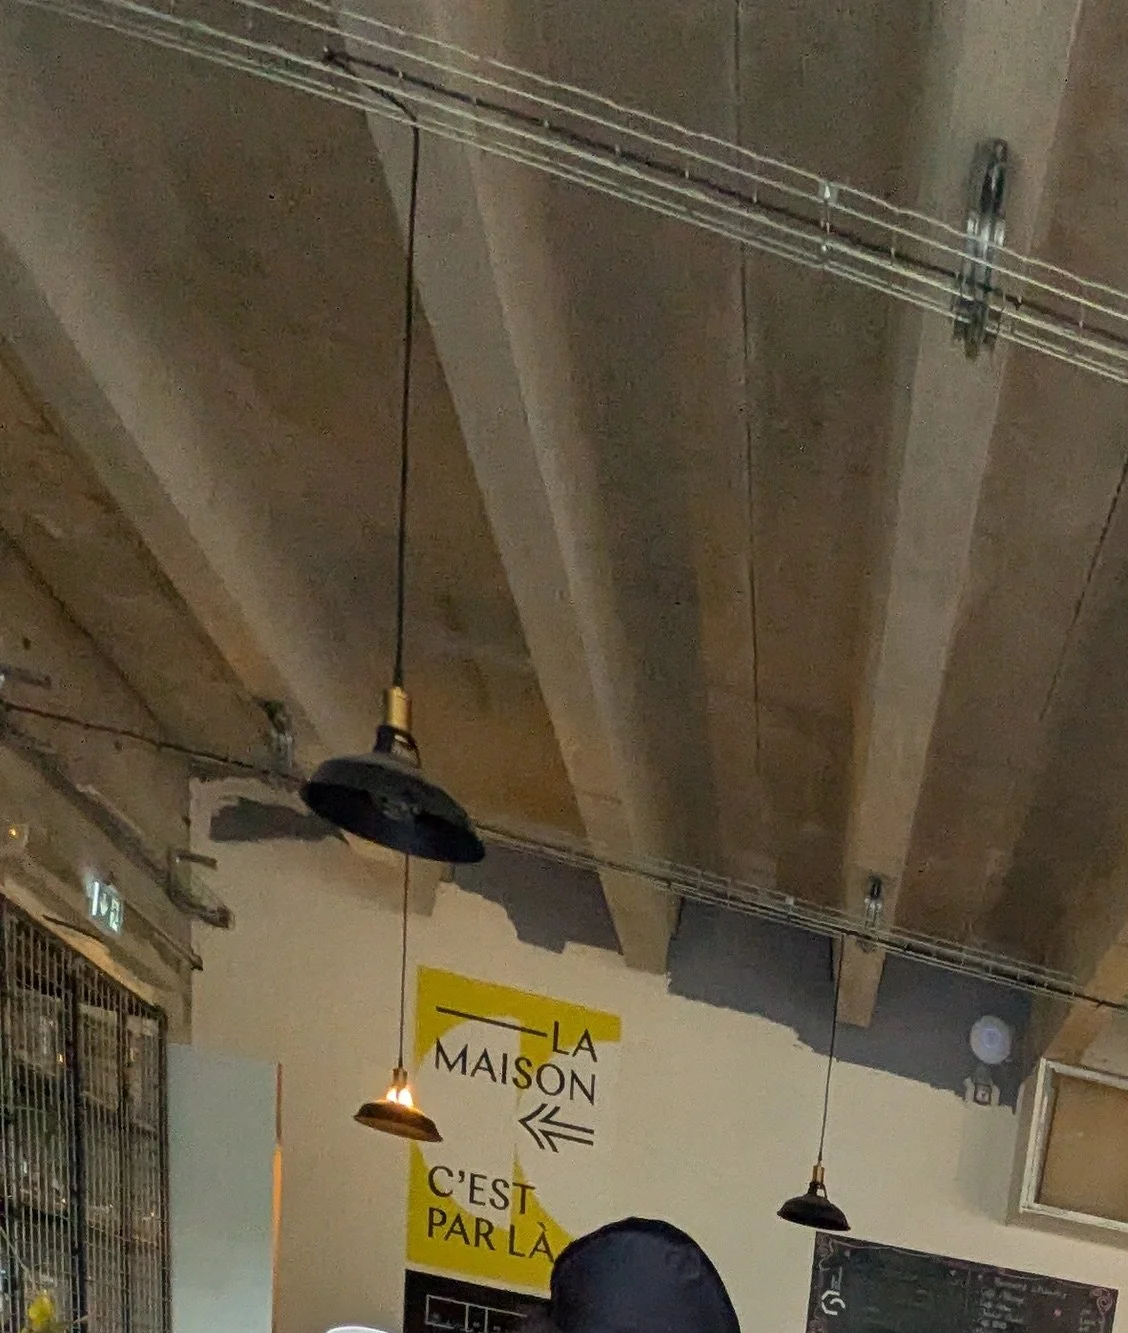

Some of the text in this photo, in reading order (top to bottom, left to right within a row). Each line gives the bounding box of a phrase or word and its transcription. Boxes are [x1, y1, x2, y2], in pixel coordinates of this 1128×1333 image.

[552, 1020, 598, 1063] LA
[434, 1036, 596, 1106] MAISON
[427, 1165, 536, 1215] C'EST
[427, 1206, 555, 1264] PAR LÀ
